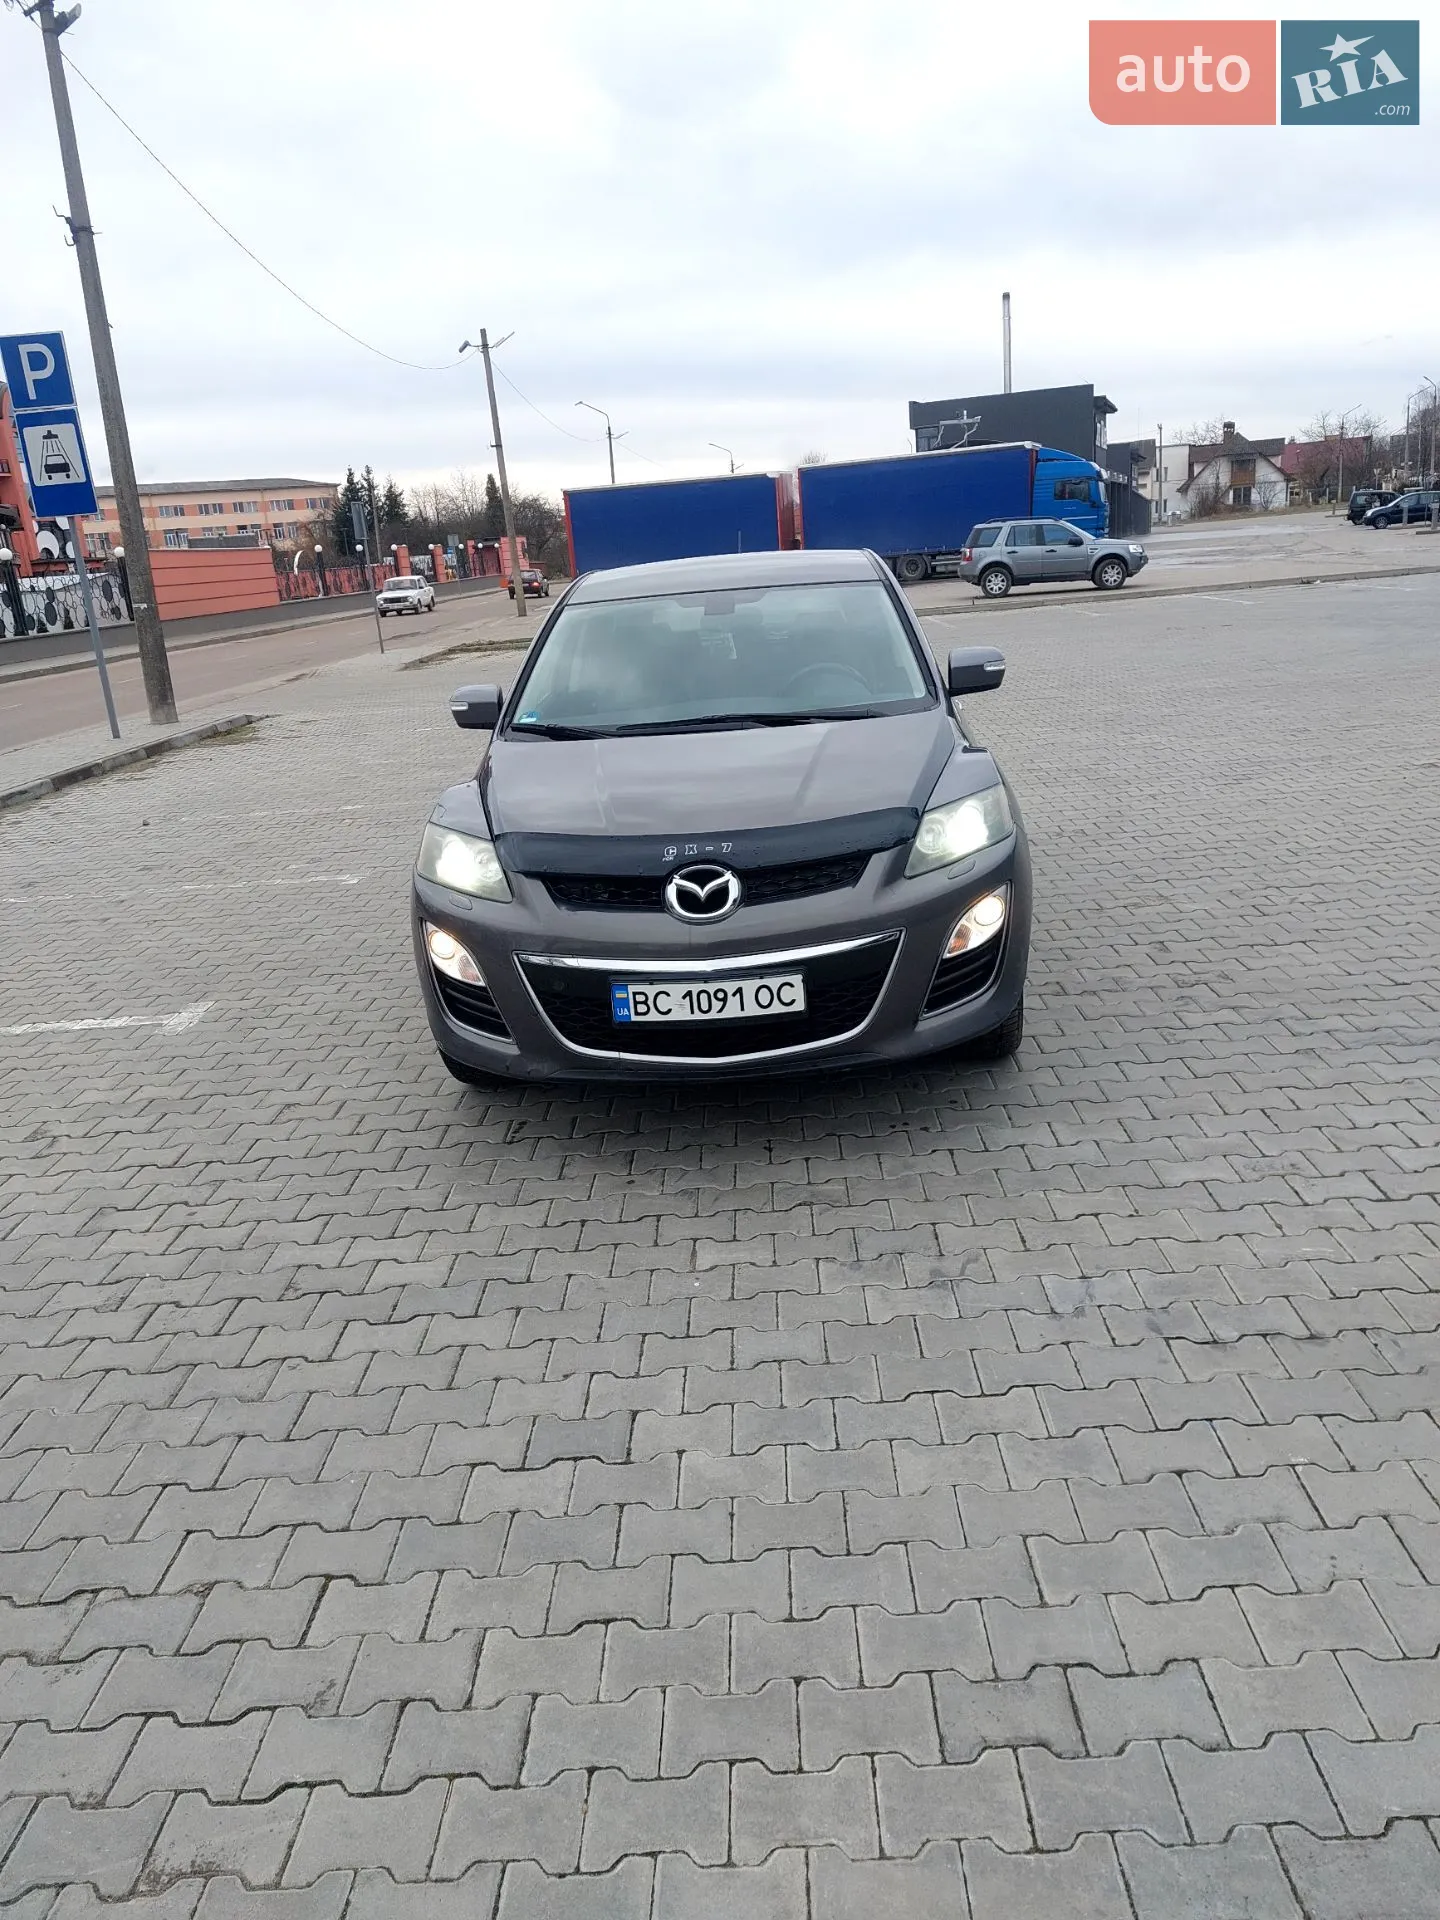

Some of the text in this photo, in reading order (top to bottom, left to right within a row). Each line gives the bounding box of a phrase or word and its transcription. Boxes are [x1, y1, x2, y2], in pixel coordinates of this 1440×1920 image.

[18, 342, 56, 400] P
[617, 1007, 630, 1017] UA
[631, 981, 797, 1016] BC 1091 OC
